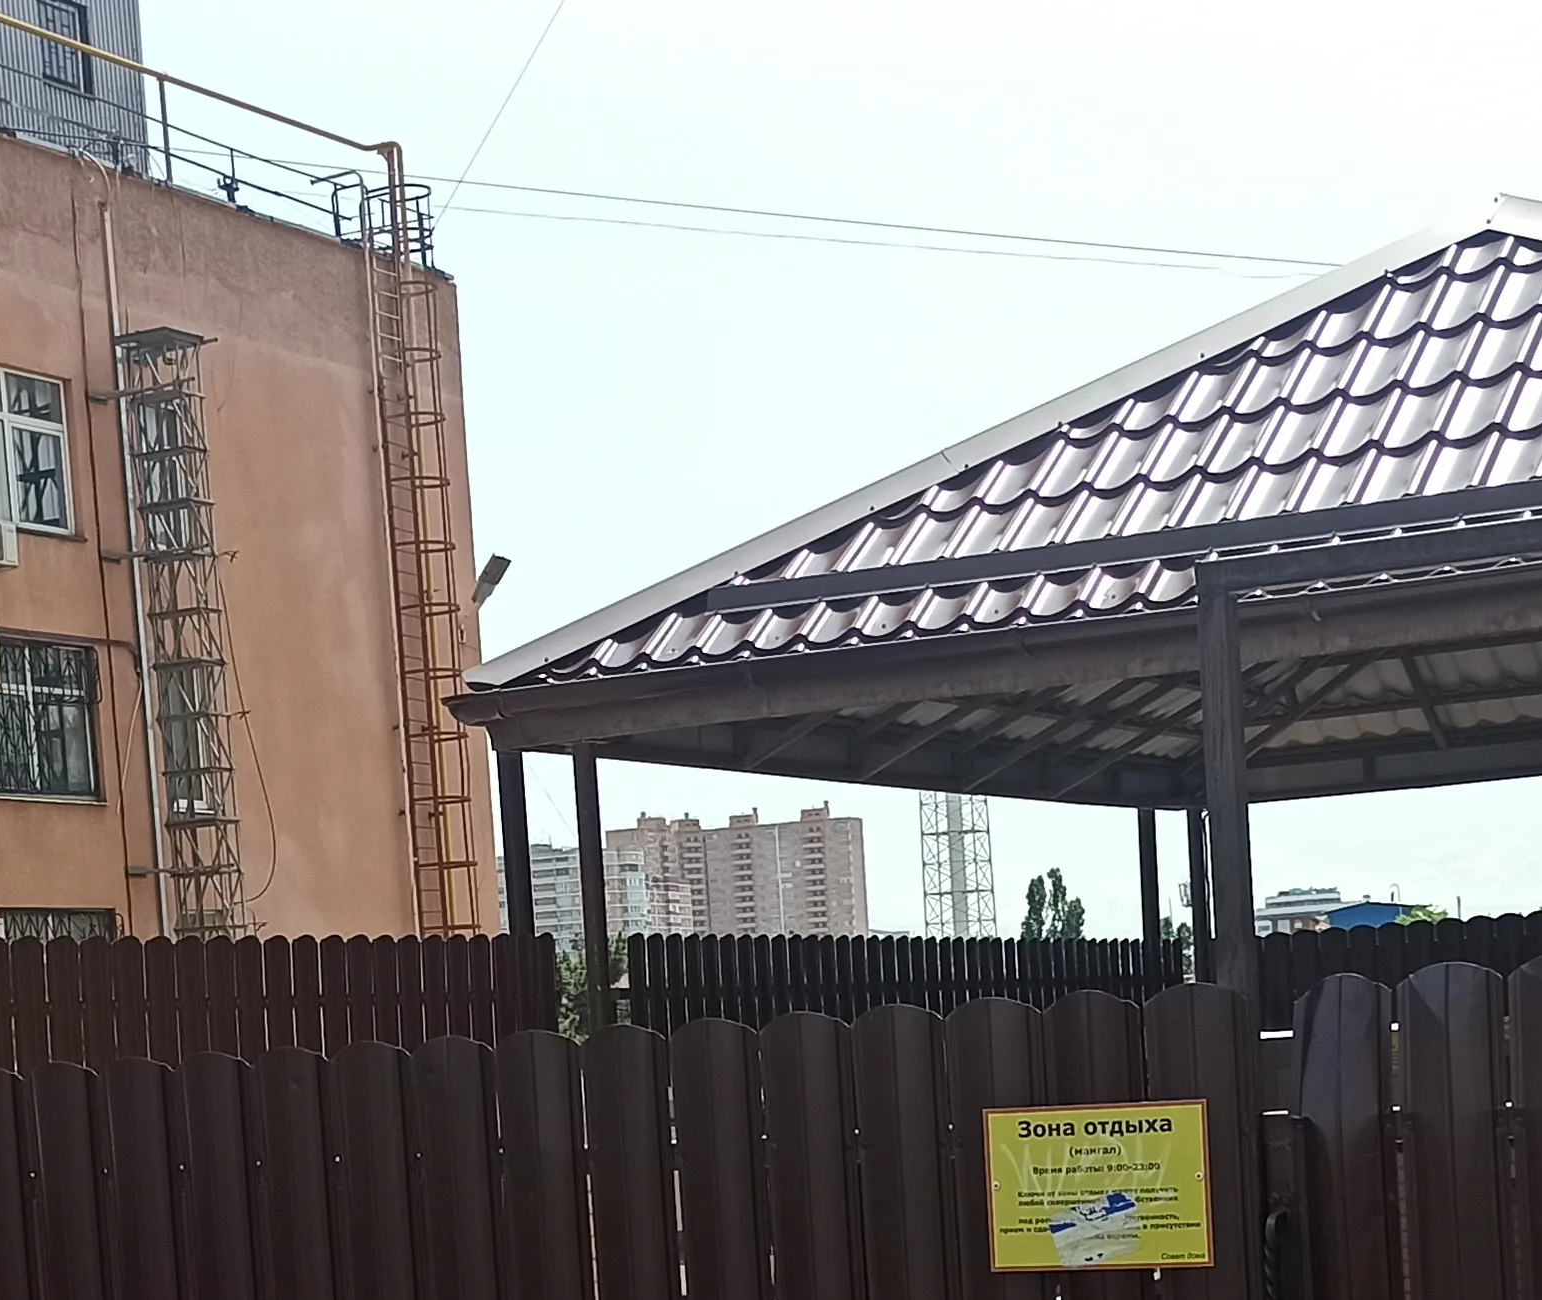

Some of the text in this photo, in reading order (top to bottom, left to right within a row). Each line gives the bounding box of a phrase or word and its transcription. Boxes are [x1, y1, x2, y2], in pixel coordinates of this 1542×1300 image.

[1018, 1118, 1173, 1138] Зона отдыха
[1069, 1146, 1122, 1158] (мангал)
[1032, 1162, 1161, 1176] Время работы: 9:00-23:00
